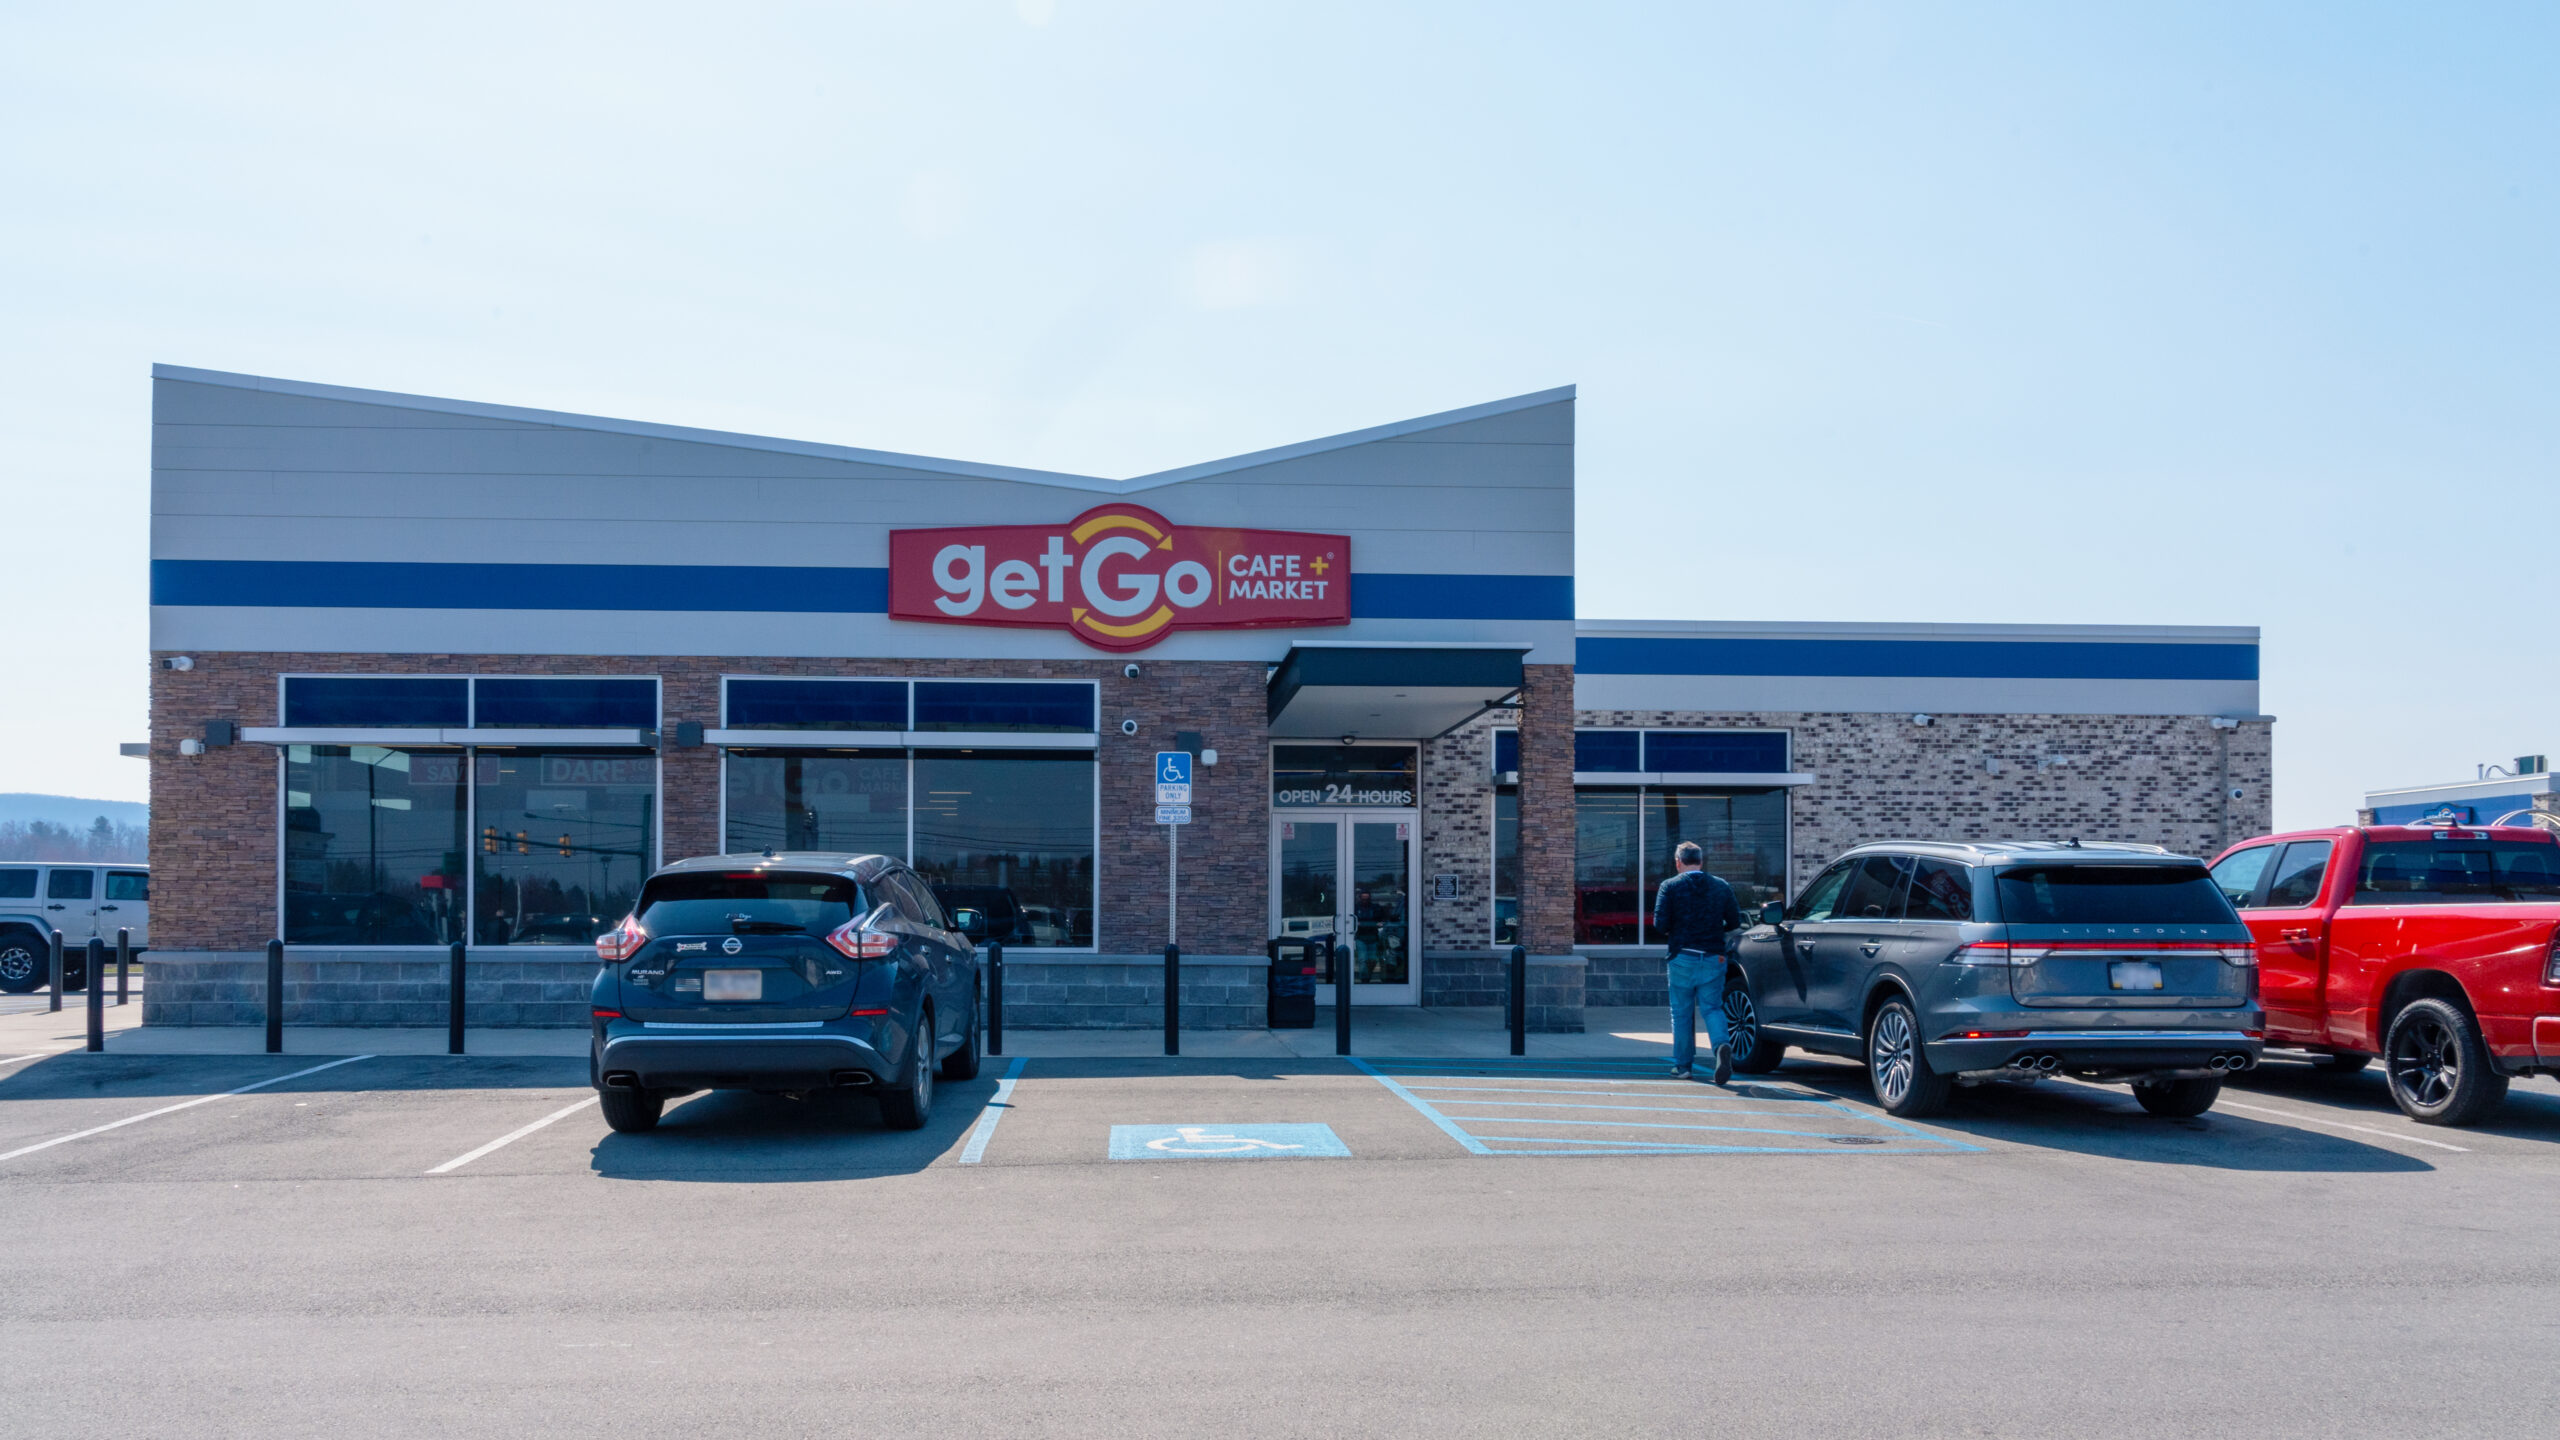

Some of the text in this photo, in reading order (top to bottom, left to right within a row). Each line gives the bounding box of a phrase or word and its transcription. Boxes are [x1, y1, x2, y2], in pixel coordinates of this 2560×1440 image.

[932, 536, 1212, 617] getGo
[1228, 554, 1301, 577] CAFE
[1229, 580, 1329, 600] MARKET
[551, 758, 627, 782] DARE
[1279, 784, 1412, 804] OPEN 24 HOURS
